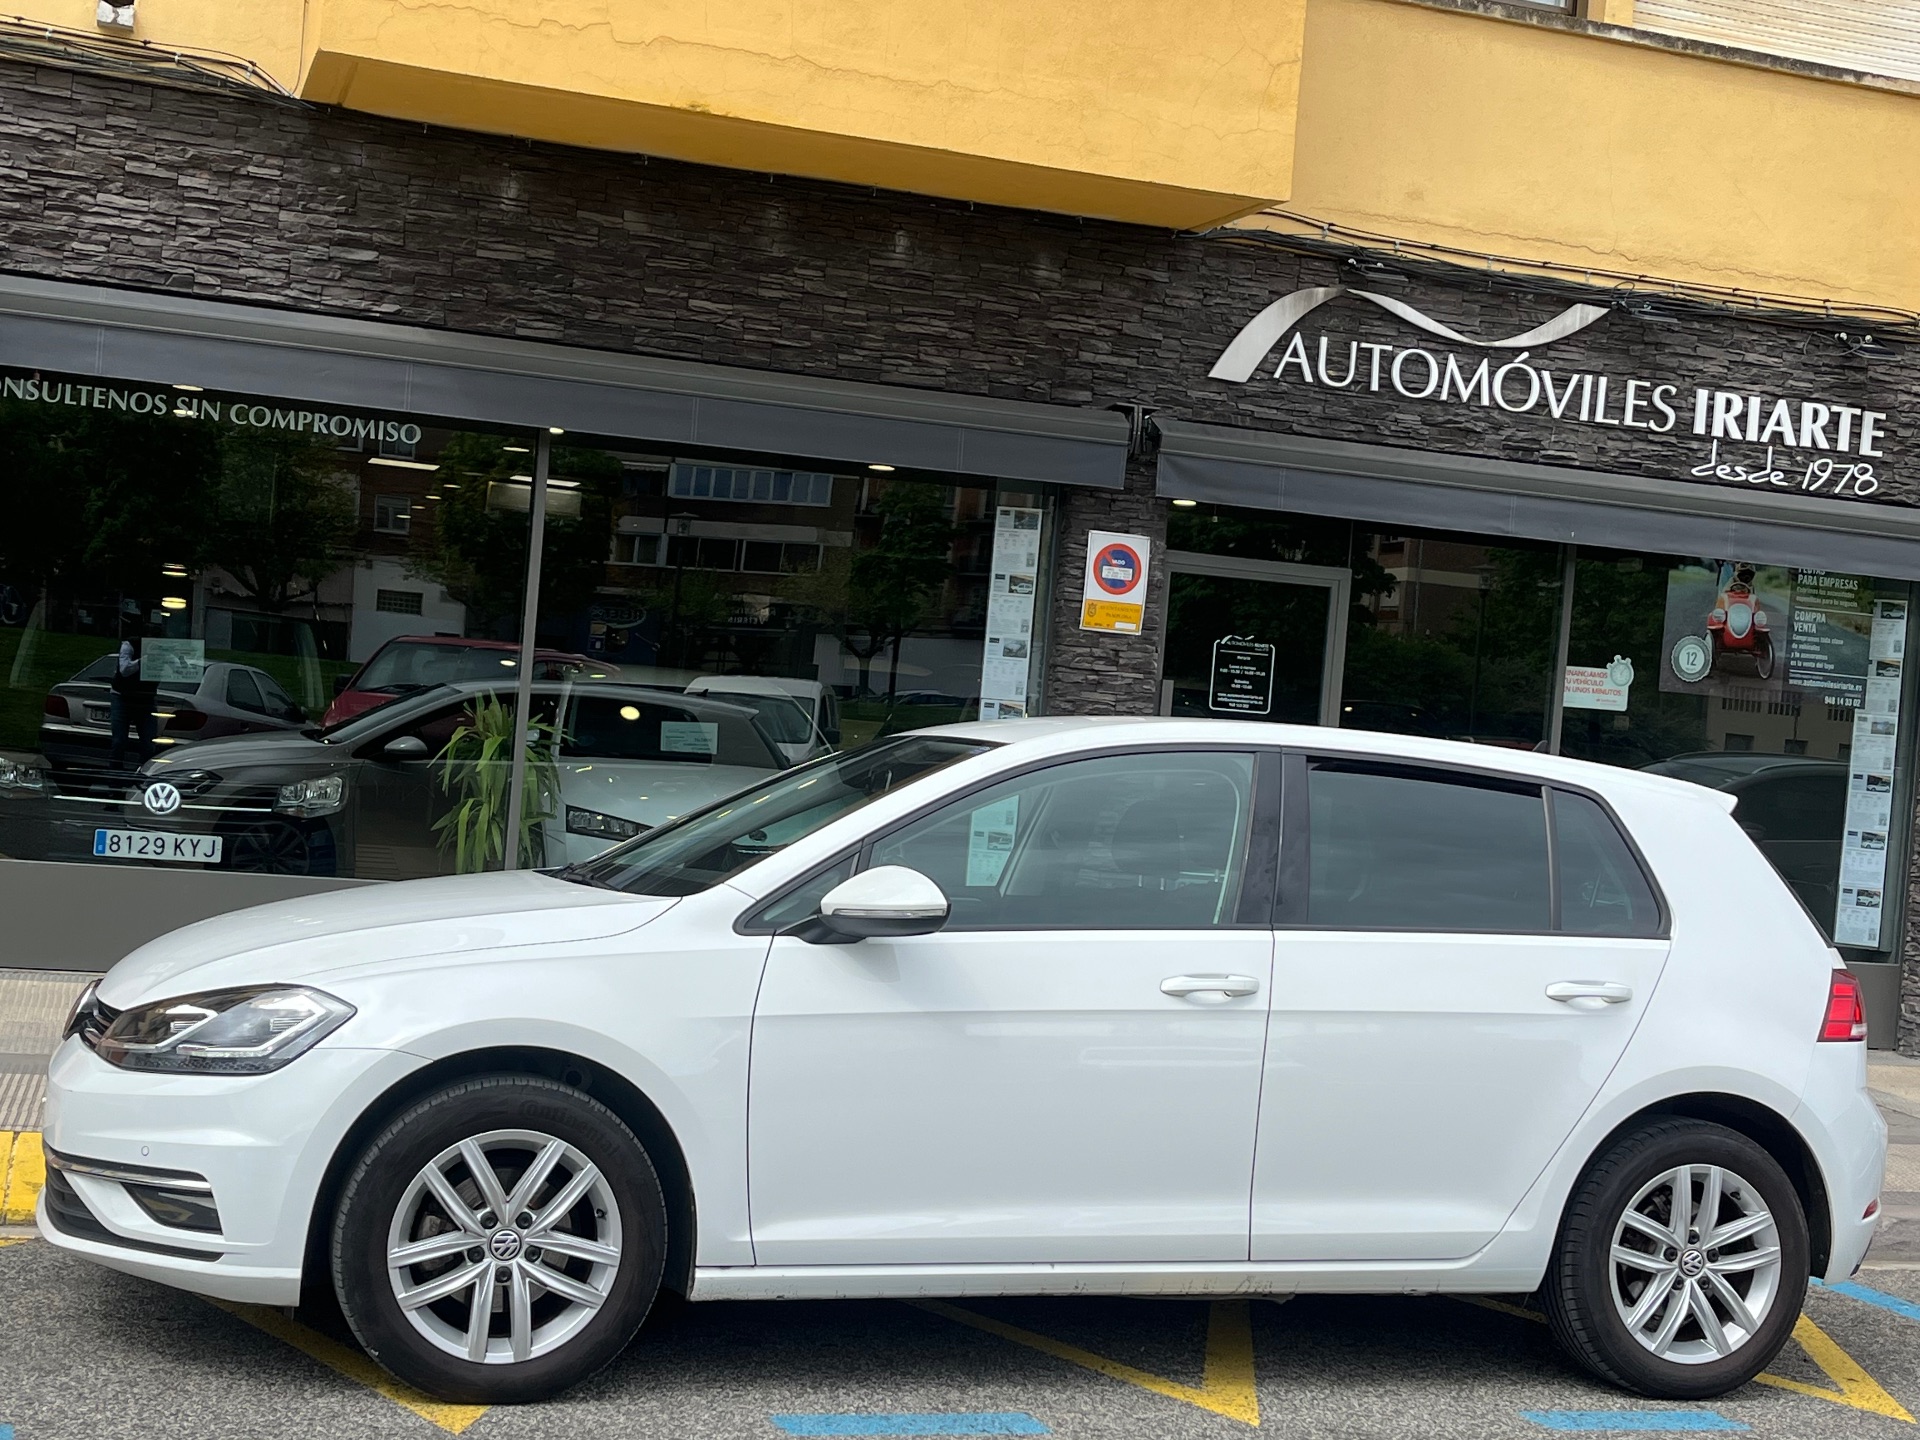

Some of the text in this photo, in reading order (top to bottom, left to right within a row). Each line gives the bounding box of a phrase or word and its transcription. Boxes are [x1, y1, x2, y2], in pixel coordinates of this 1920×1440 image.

[1272, 331, 1887, 458] AUTOMÓVILES IRIARTE
[0, 376, 422, 445] NSULTENOS SIN COMPROMISO
[1691, 438, 1879, 497] desde 1978
[1797, 574, 1858, 590] PARA EMPRESAS
[1794, 610, 1827, 623] COMPRA
[1793, 621, 1817, 633] VENTA
[1686, 652, 1697, 666] 12
[1566, 669, 1608, 679] INANCIAMOS
[1824, 696, 1861, 707] 948 14 33 02
[109, 834, 216, 858] 8129 KYJ
